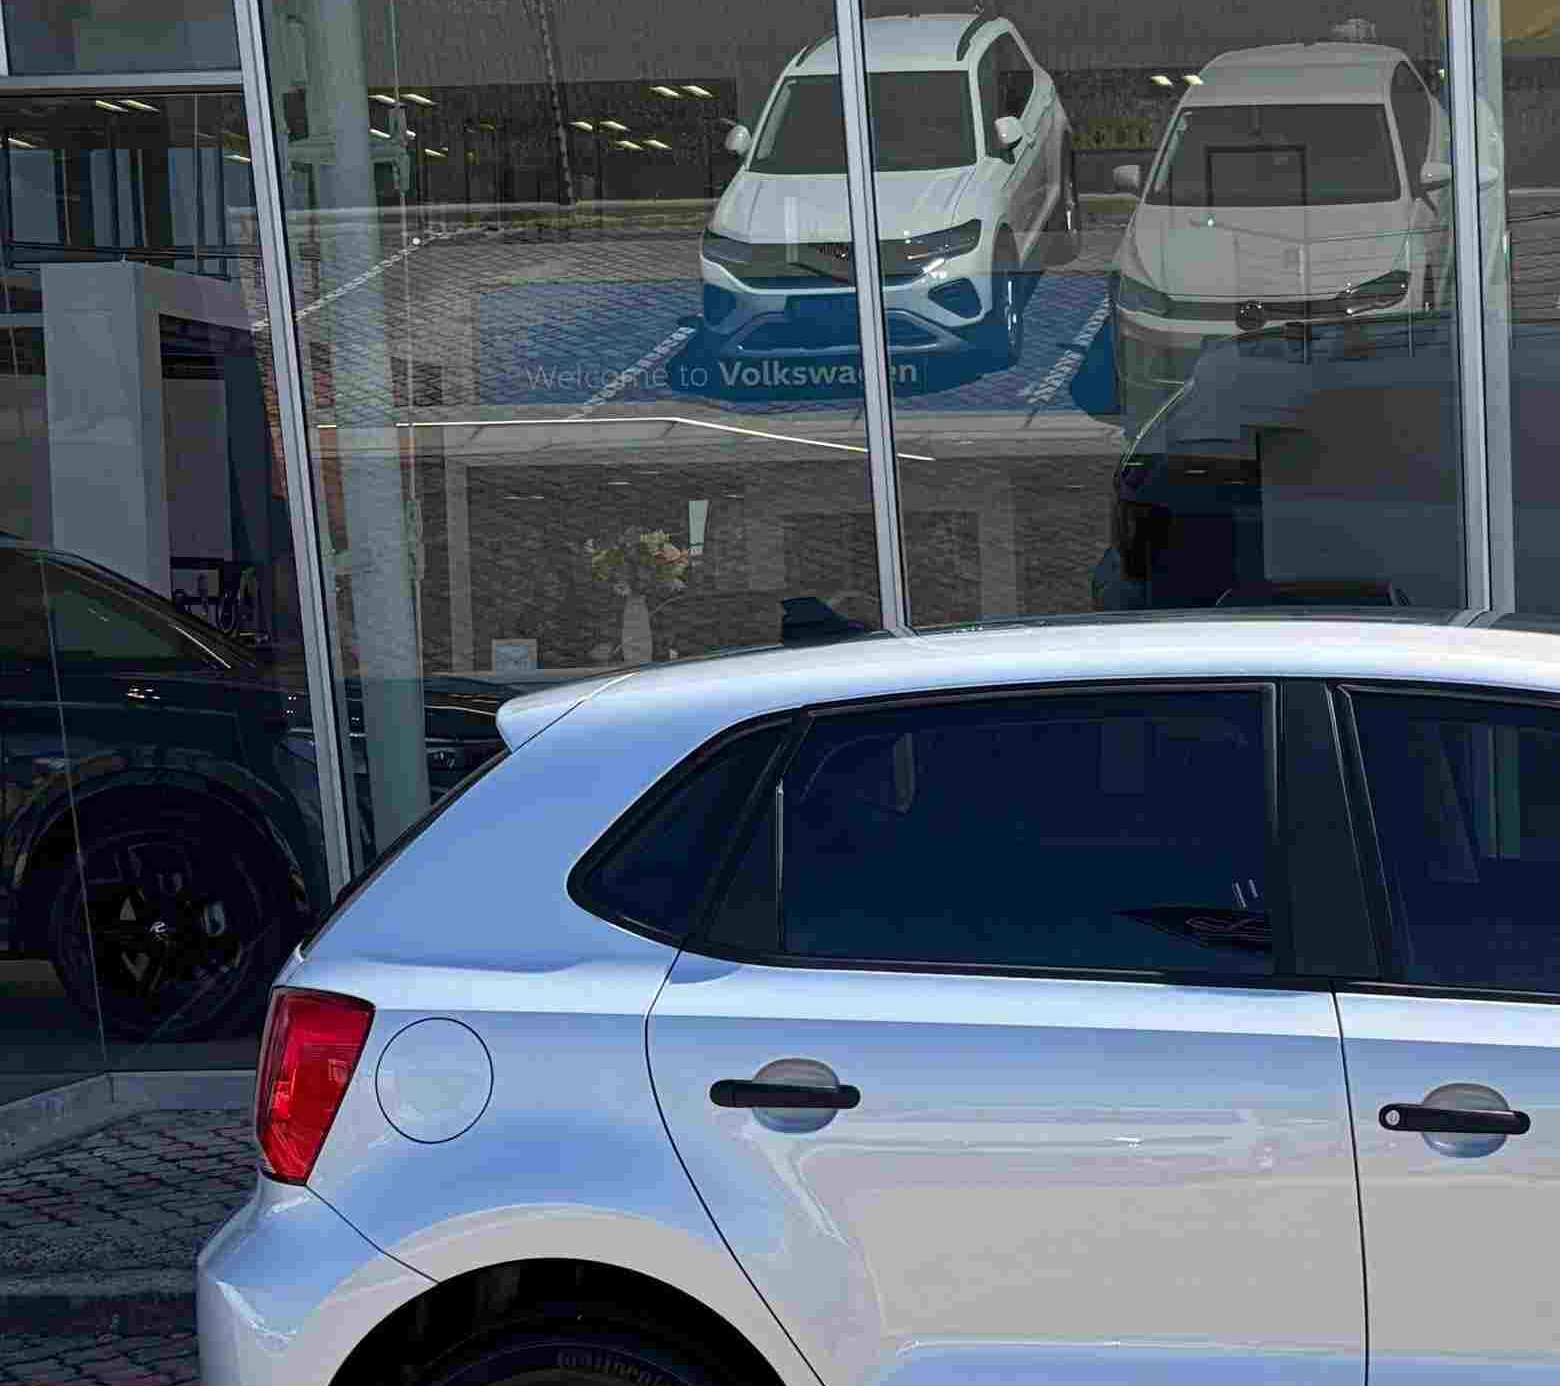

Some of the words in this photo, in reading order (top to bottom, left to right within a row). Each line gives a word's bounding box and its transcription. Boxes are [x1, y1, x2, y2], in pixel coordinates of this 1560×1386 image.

[525, 363, 668, 389] Welcome
[680, 365, 708, 388] to
[719, 360, 917, 386] Volkswan
